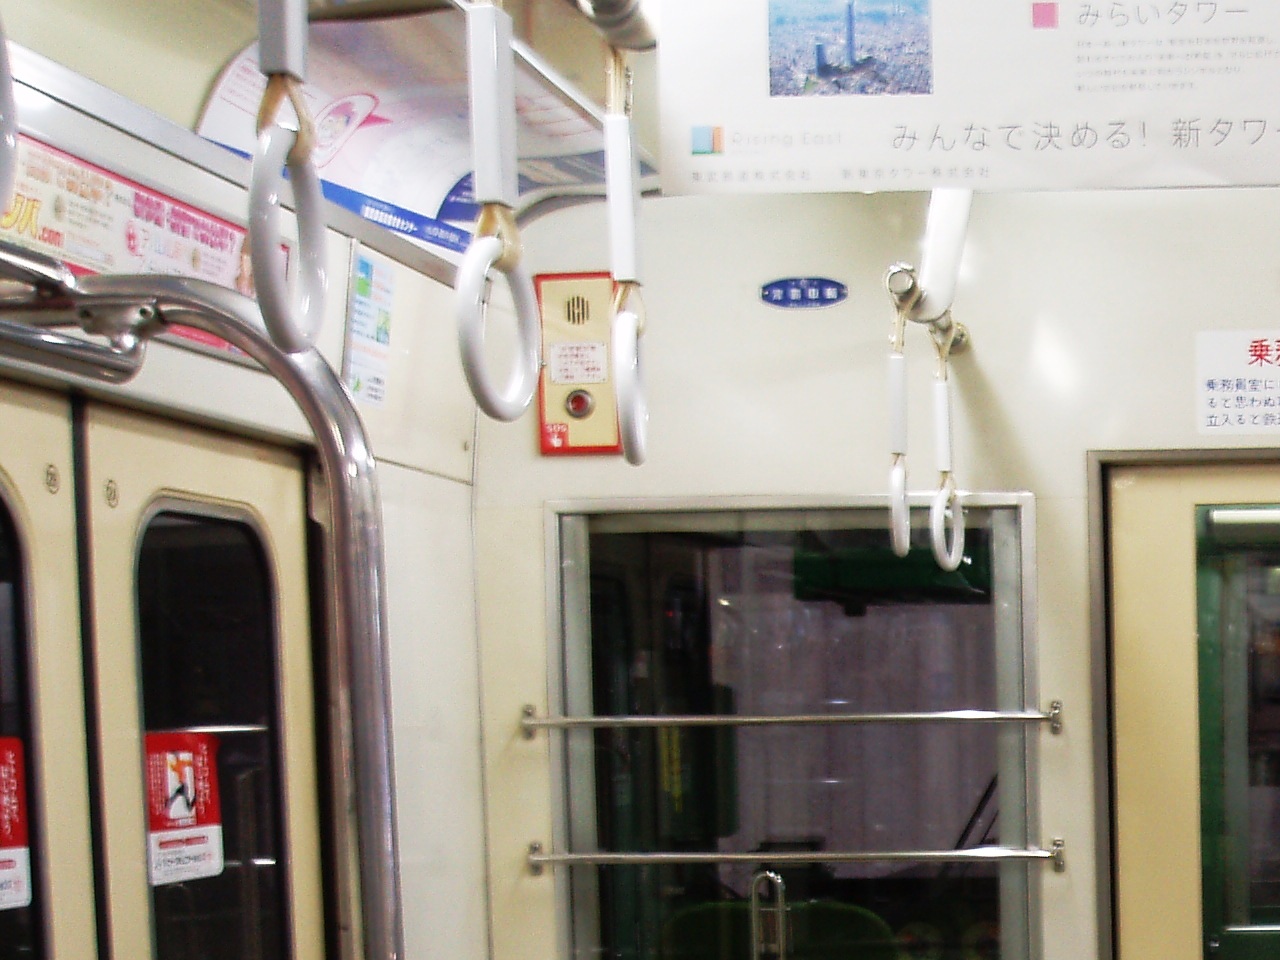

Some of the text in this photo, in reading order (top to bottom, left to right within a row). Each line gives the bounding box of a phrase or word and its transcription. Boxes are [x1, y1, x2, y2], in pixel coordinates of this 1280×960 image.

[1078, 1, 1249, 28] みらいタワー
